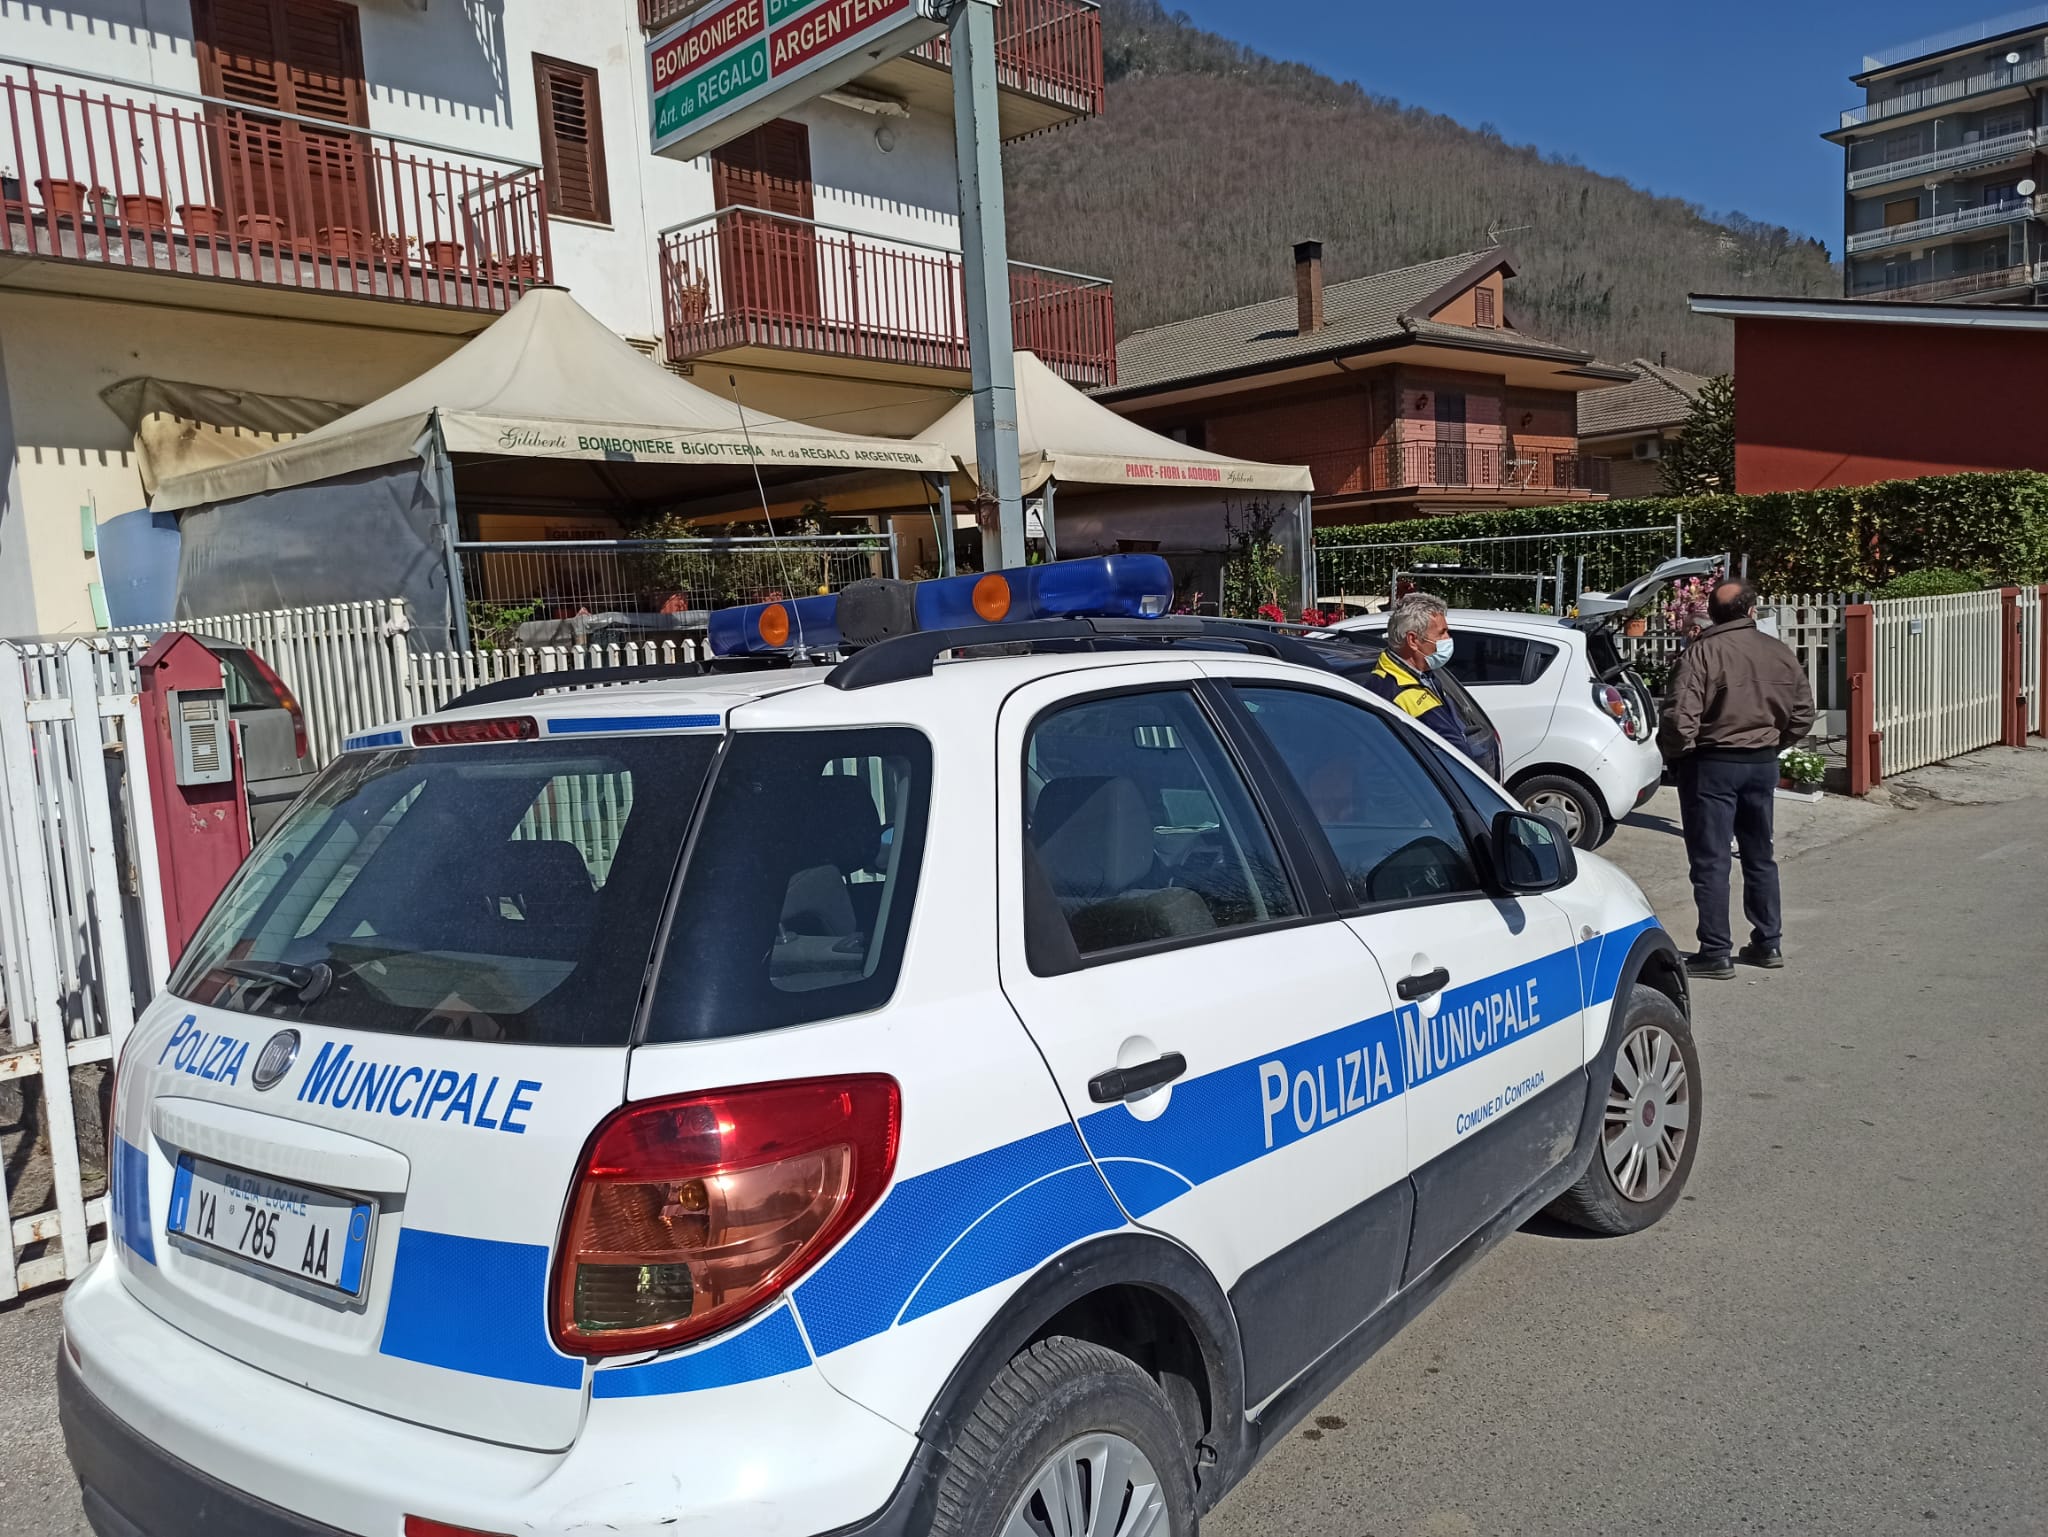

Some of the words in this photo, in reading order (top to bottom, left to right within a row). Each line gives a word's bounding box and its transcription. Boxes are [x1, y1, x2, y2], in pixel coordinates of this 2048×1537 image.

[656, 1, 760, 82] BOMBONIERE
[774, 0, 894, 67] ARGENTER
[660, 105, 678, 129] Art.
[681, 97, 694, 117] da
[697, 51, 764, 108] REGALO
[498, 425, 568, 449] Giliberti
[578, 436, 675, 454] BOMBONIERE
[771, 448, 786, 458] Art.
[788, 449, 799, 458] da
[800, 447, 850, 461] REGALO
[855, 450, 923, 464] ARGENTERIA
[1126, 464, 1154, 478] PIANTE
[1160, 466, 1180, 479] FIORI
[158, 1014, 250, 1087] POLIZIA
[297, 1041, 542, 1134] MUNICIPALE
[1259, 1041, 1393, 1149] POLIZIA
[1402, 977, 1541, 1085] MUNICIPALE
[1456, 1100, 1494, 1135] COMUNE
[1495, 1095, 1503, 1113] DI
[1504, 1070, 1545, 1106] CONTRADA
[224, 1173, 260, 1201] POLIZIA
[265, 1184, 310, 1217] LOCALE
[197, 1190, 217, 1241] YA
[239, 1205, 281, 1260] 785
[301, 1224, 330, 1279] AA
